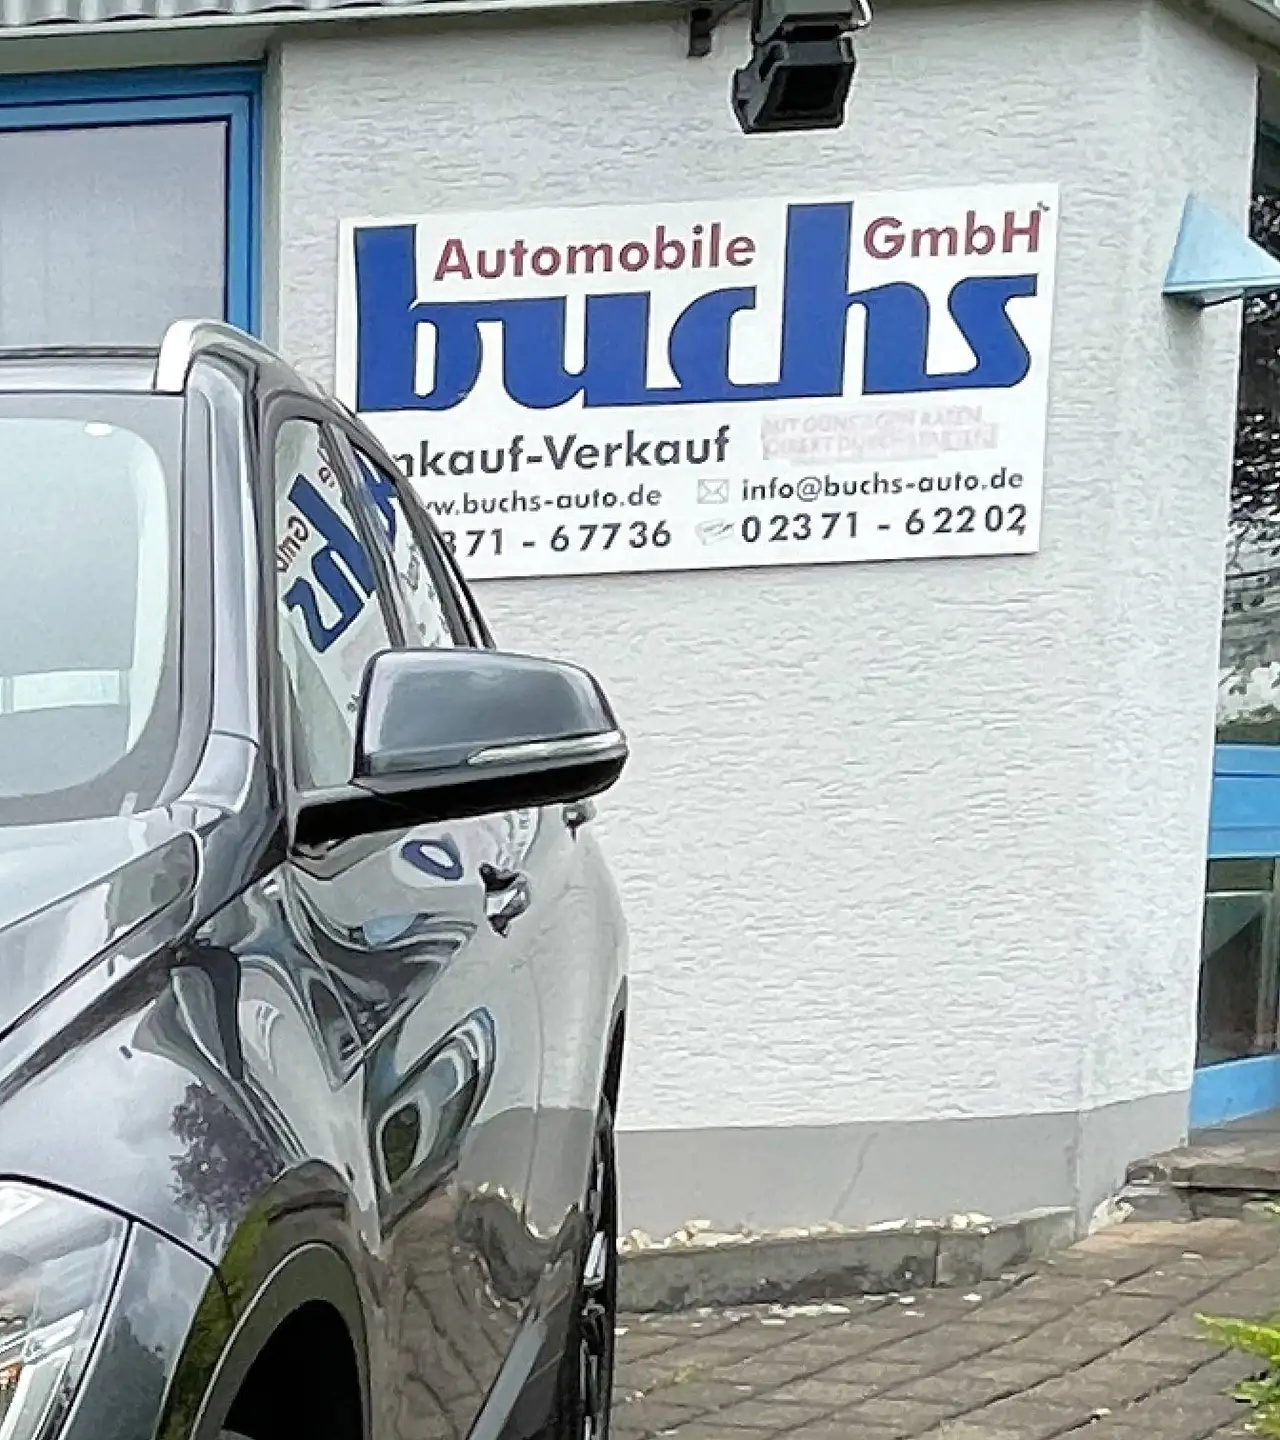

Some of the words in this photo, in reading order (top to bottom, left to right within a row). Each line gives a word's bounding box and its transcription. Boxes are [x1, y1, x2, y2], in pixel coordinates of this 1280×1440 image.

[434, 222, 757, 282] Automobile
[863, 208, 1041, 260] GmbH
[352, 200, 1039, 414] buchs
[391, 424, 730, 478] nkauf-Verkauf
[424, 482, 663, 516] w.buchs-auto.de
[741, 466, 1024, 503] info@buchs-auto.de
[440, 528, 503, 557] 371
[550, 519, 671, 553] 67736
[741, 511, 858, 543] 02371
[904, 503, 1028, 536] 62202
